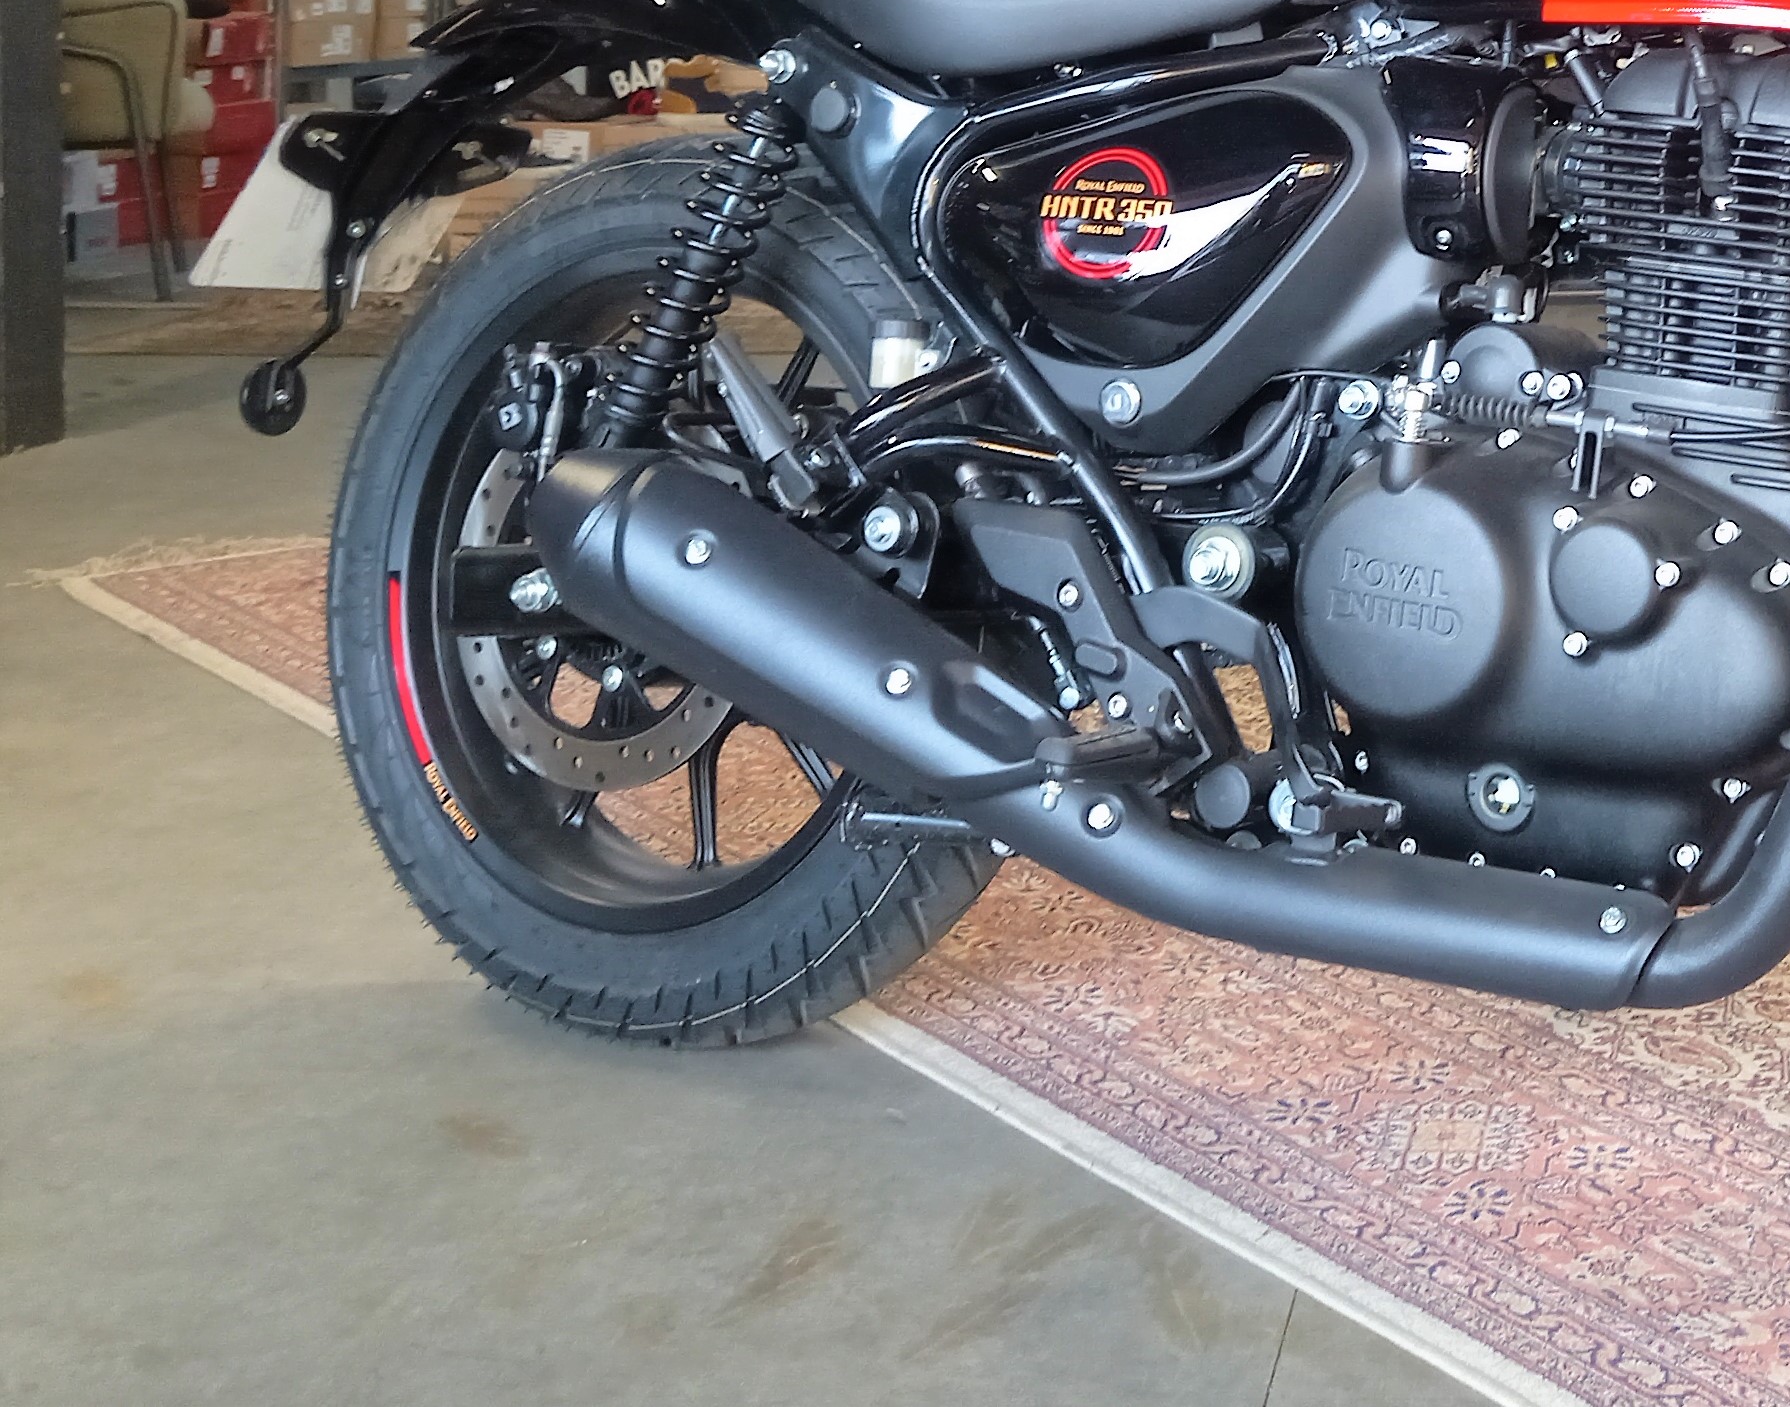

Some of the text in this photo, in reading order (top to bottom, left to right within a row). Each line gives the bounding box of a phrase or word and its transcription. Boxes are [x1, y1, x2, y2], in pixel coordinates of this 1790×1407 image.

[609, 58, 685, 99] BAR
[1040, 195, 1173, 224] HNTR 350
[1341, 547, 1449, 600] ROYAL
[1326, 587, 1464, 641] ENFIELD
[423, 761, 450, 803] ROYAL
